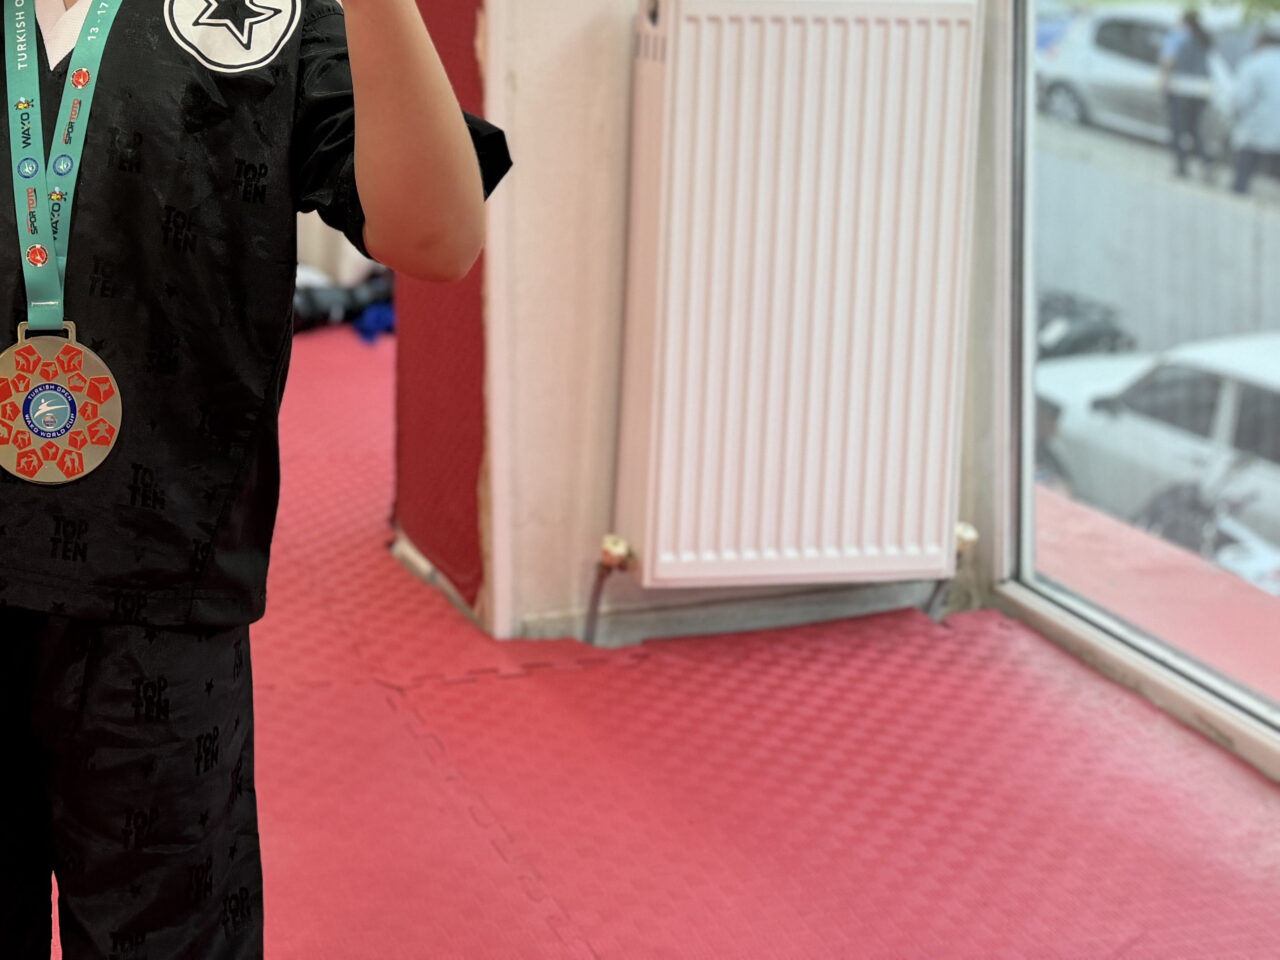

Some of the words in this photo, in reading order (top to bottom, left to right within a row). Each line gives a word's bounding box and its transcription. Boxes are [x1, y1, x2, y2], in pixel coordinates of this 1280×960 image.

[87, 27, 99, 41] 13
[97, 2, 109, 15] 17
[15, 11, 28, 70] TURKISH
[21, 112, 32, 149] WAKO
[234, 157, 268, 182] TOP
[27, 385, 55, 400] TURKISH
[56, 386, 72, 401] OPEN
[25, 414, 39, 433] WAKO
[40, 428, 65, 438] WORLD
[52, 515, 89, 538] TOP
[50, 537, 88, 562] TEN
[131, 676, 168, 703] TOP
